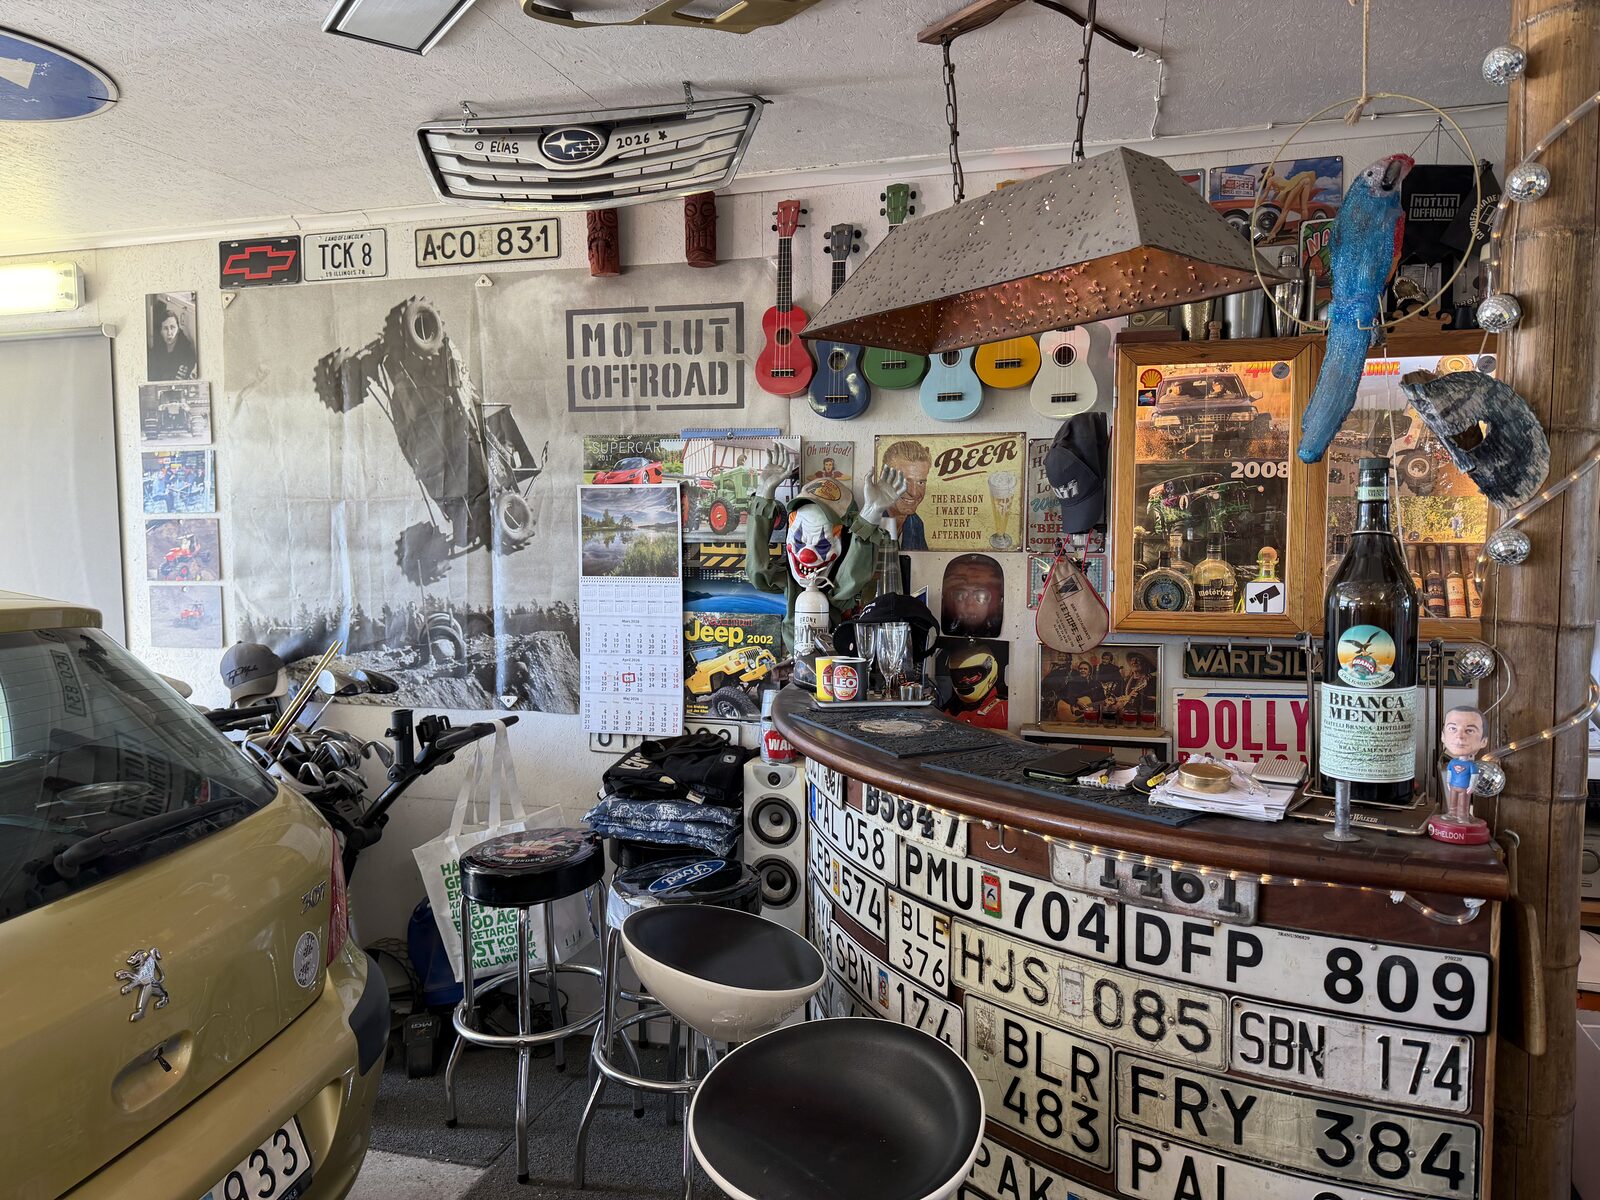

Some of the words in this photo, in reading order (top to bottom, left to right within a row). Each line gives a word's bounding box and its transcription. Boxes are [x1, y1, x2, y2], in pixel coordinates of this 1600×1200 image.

[490, 140, 520, 155] ELIAS
[616, 132, 651, 149] 2026
[1412, 207, 1455, 218] OFFROAD
[1414, 197, 1456, 208] MOTLUT
[318, 241, 355, 270] TCK
[361, 242, 372, 267] 8
[581, 318, 730, 358] MOTLUT
[581, 361, 729, 400] OFFROAD
[806, 445, 818, 457] Oh
[819, 446, 831, 457] my
[832, 442, 853, 457] God!
[934, 440, 1018, 477] BEER
[1230, 461, 1290, 479] 2008
[932, 494, 949, 504] THE
[950, 494, 984, 504] REASON
[935, 506, 940, 516] I
[941, 506, 965, 516] WAKE
[967, 506, 979, 516] UP
[931, 530, 982, 540] AFTERNOON
[943, 518, 970, 528] EVERY
[684, 619, 744, 648] Jeep
[746, 634, 774, 645] 2002
[834, 676, 858, 688] LEO
[1329, 692, 1405, 709] BRANCA
[1329, 706, 1405, 723] MENTA
[1178, 699, 1309, 752] DOLLY
[816, 789, 839, 842] PAL
[845, 811, 885, 870] 058
[1434, 829, 1465, 840] SHELDON
[661, 863, 713, 886] Ford
[811, 829, 831, 886] LEB
[842, 864, 882, 931] 574
[301, 880, 327, 914] 307
[905, 845, 974, 911] PMU
[1008, 880, 1110, 954] 704
[901, 901, 946, 950] BLE
[902, 939, 945, 988] 376
[1135, 911, 1264, 983] DFP
[1323, 947, 1475, 1021] 809
[835, 933, 873, 1001] SBN
[896, 982, 953, 1048] 174
[959, 931, 1049, 1007] HJS
[1092, 977, 1212, 1053] 085
[1002, 1018, 1100, 1101] BLR
[1239, 1010, 1325, 1079] SBN
[1375, 1034, 1463, 1101] 174
[1002, 1075, 1100, 1153] 483
[1130, 1064, 1258, 1146] FRY
[1315, 1108, 1465, 1191] 384
[224, 1128, 298, 1200] 933
